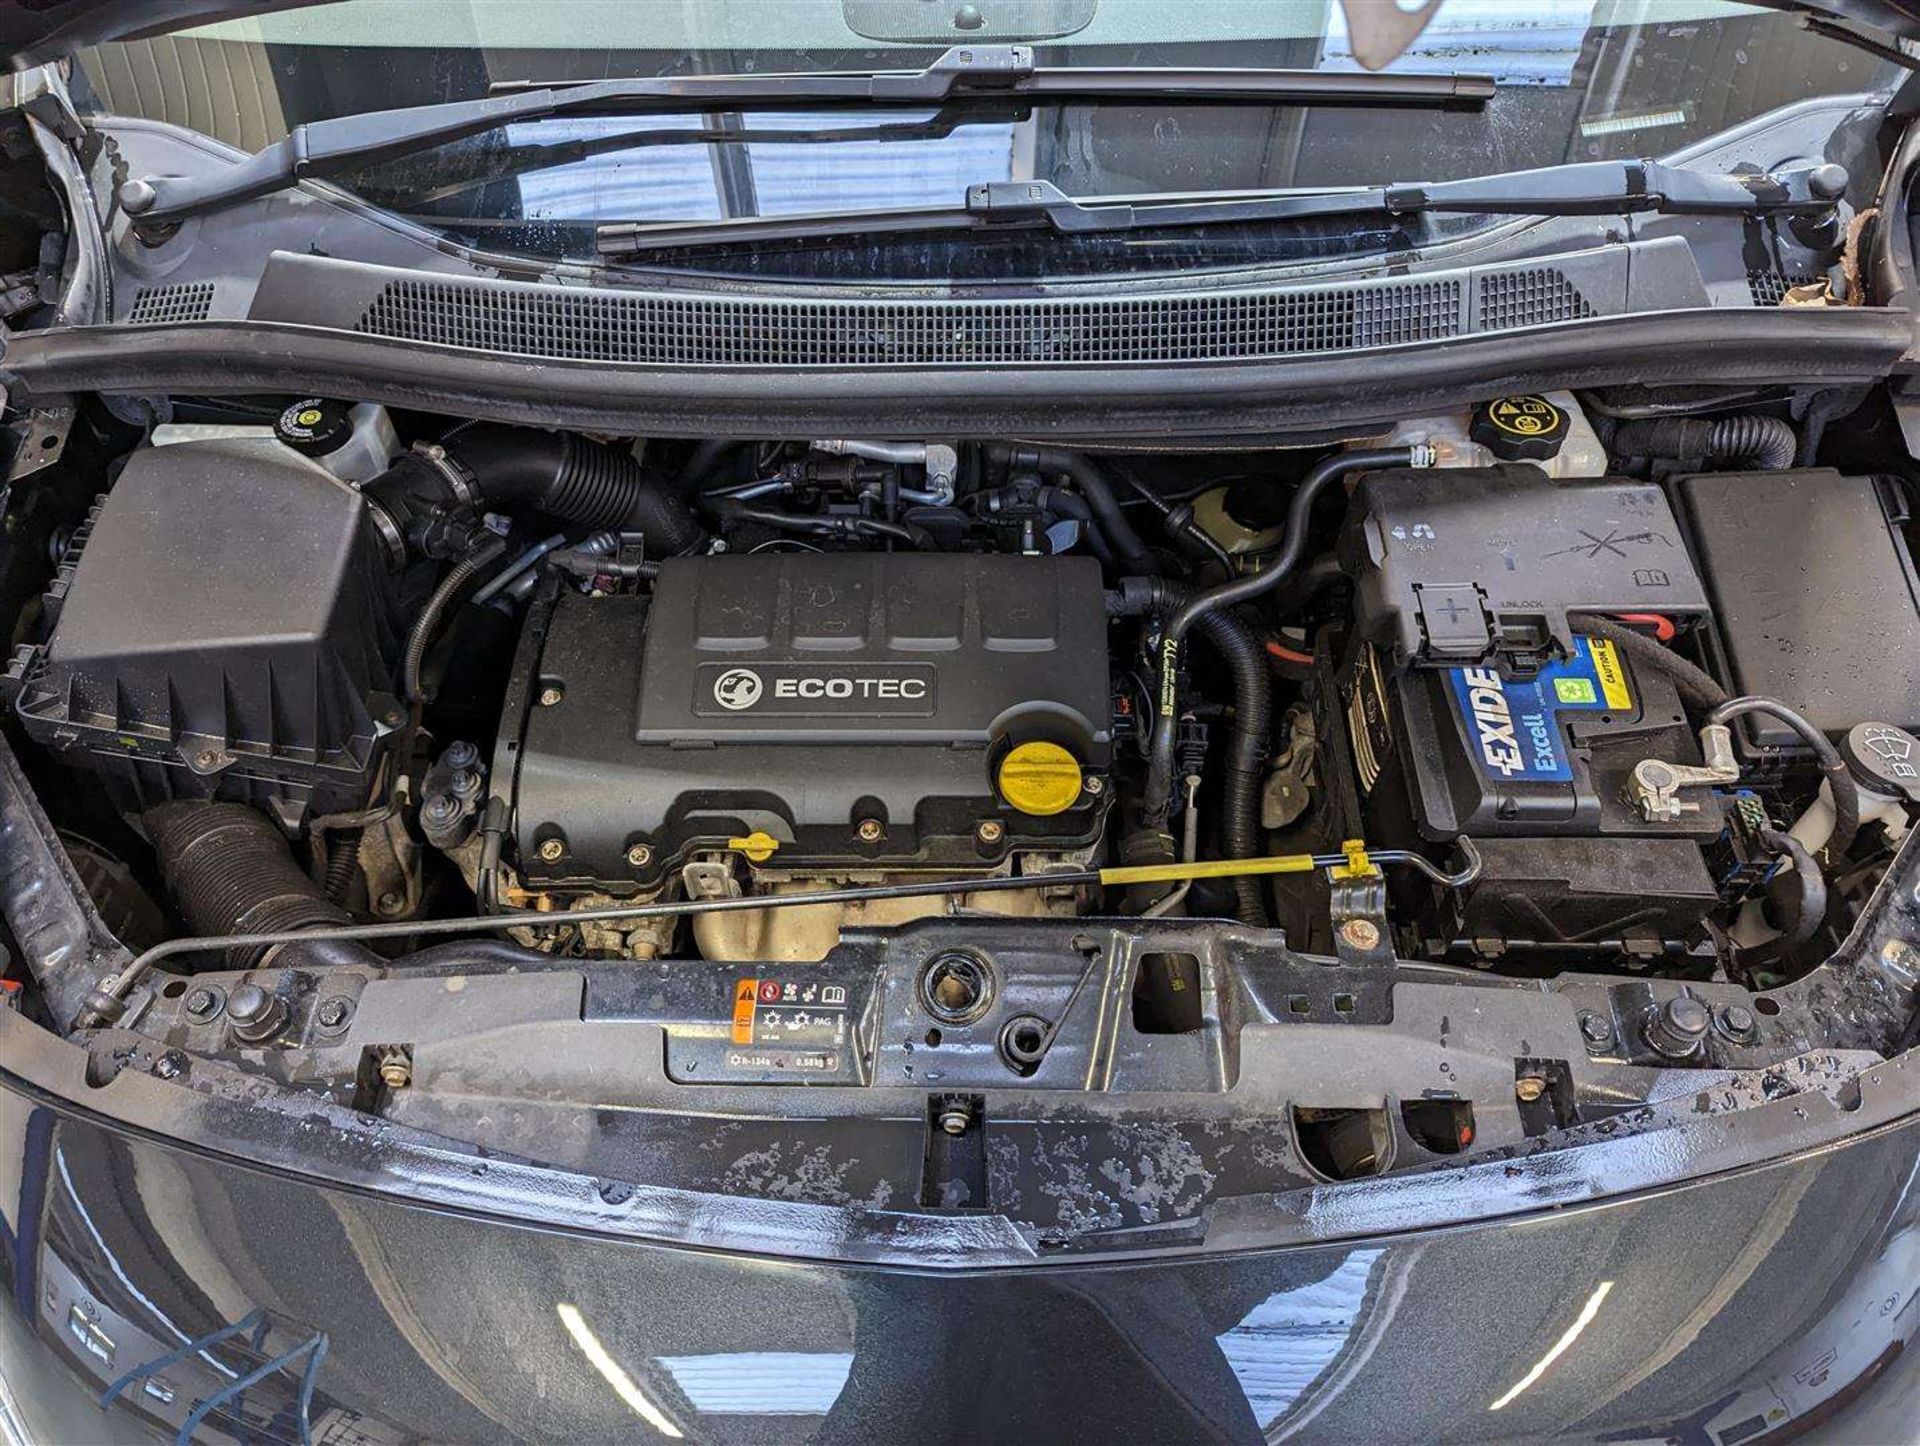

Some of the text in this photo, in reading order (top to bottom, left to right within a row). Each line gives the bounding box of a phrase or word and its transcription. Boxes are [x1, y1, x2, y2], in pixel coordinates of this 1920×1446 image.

[1501, 600, 1544, 609] UNLOCK
[1600, 651, 1616, 684] CAUTION
[774, 678, 926, 698] ECOTEC
[1462, 667, 1525, 776] EXIDE
[1521, 712, 1558, 772] Excell
[813, 1017, 831, 1026] PAG
